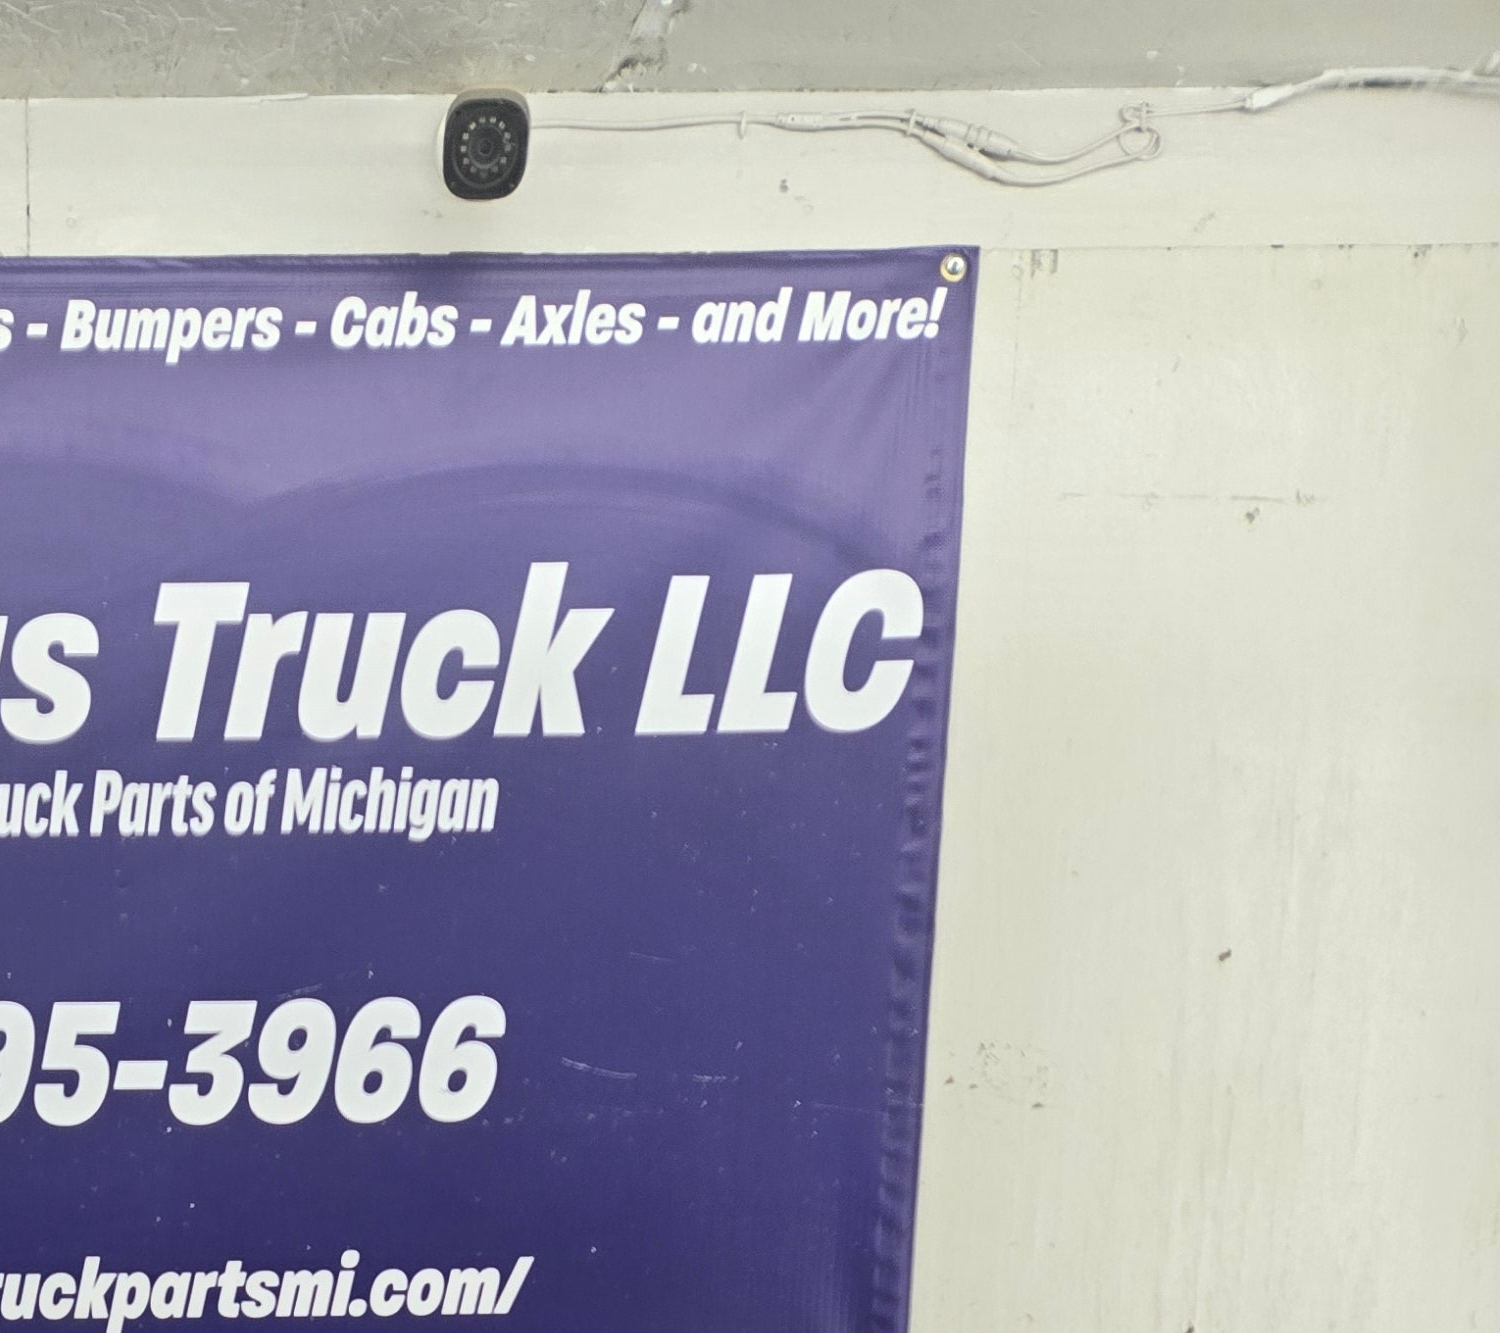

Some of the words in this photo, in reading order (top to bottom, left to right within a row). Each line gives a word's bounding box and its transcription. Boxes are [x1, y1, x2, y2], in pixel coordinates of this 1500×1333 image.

[24, 321, 50, 340] -
[58, 297, 285, 368] Bumpers
[293, 319, 319, 338] -
[328, 289, 460, 352] Cabs
[468, 317, 494, 335] -
[498, 287, 648, 350] Axles
[655, 314, 682, 333] -
[690, 284, 795, 347] and
[795, 285, 950, 345] More!
[152, 560, 617, 744] Truck
[633, 567, 925, 737] LLC
[88, 768, 218, 838] Parts
[222, 767, 279, 837] of
[279, 764, 501, 843] Michigan
